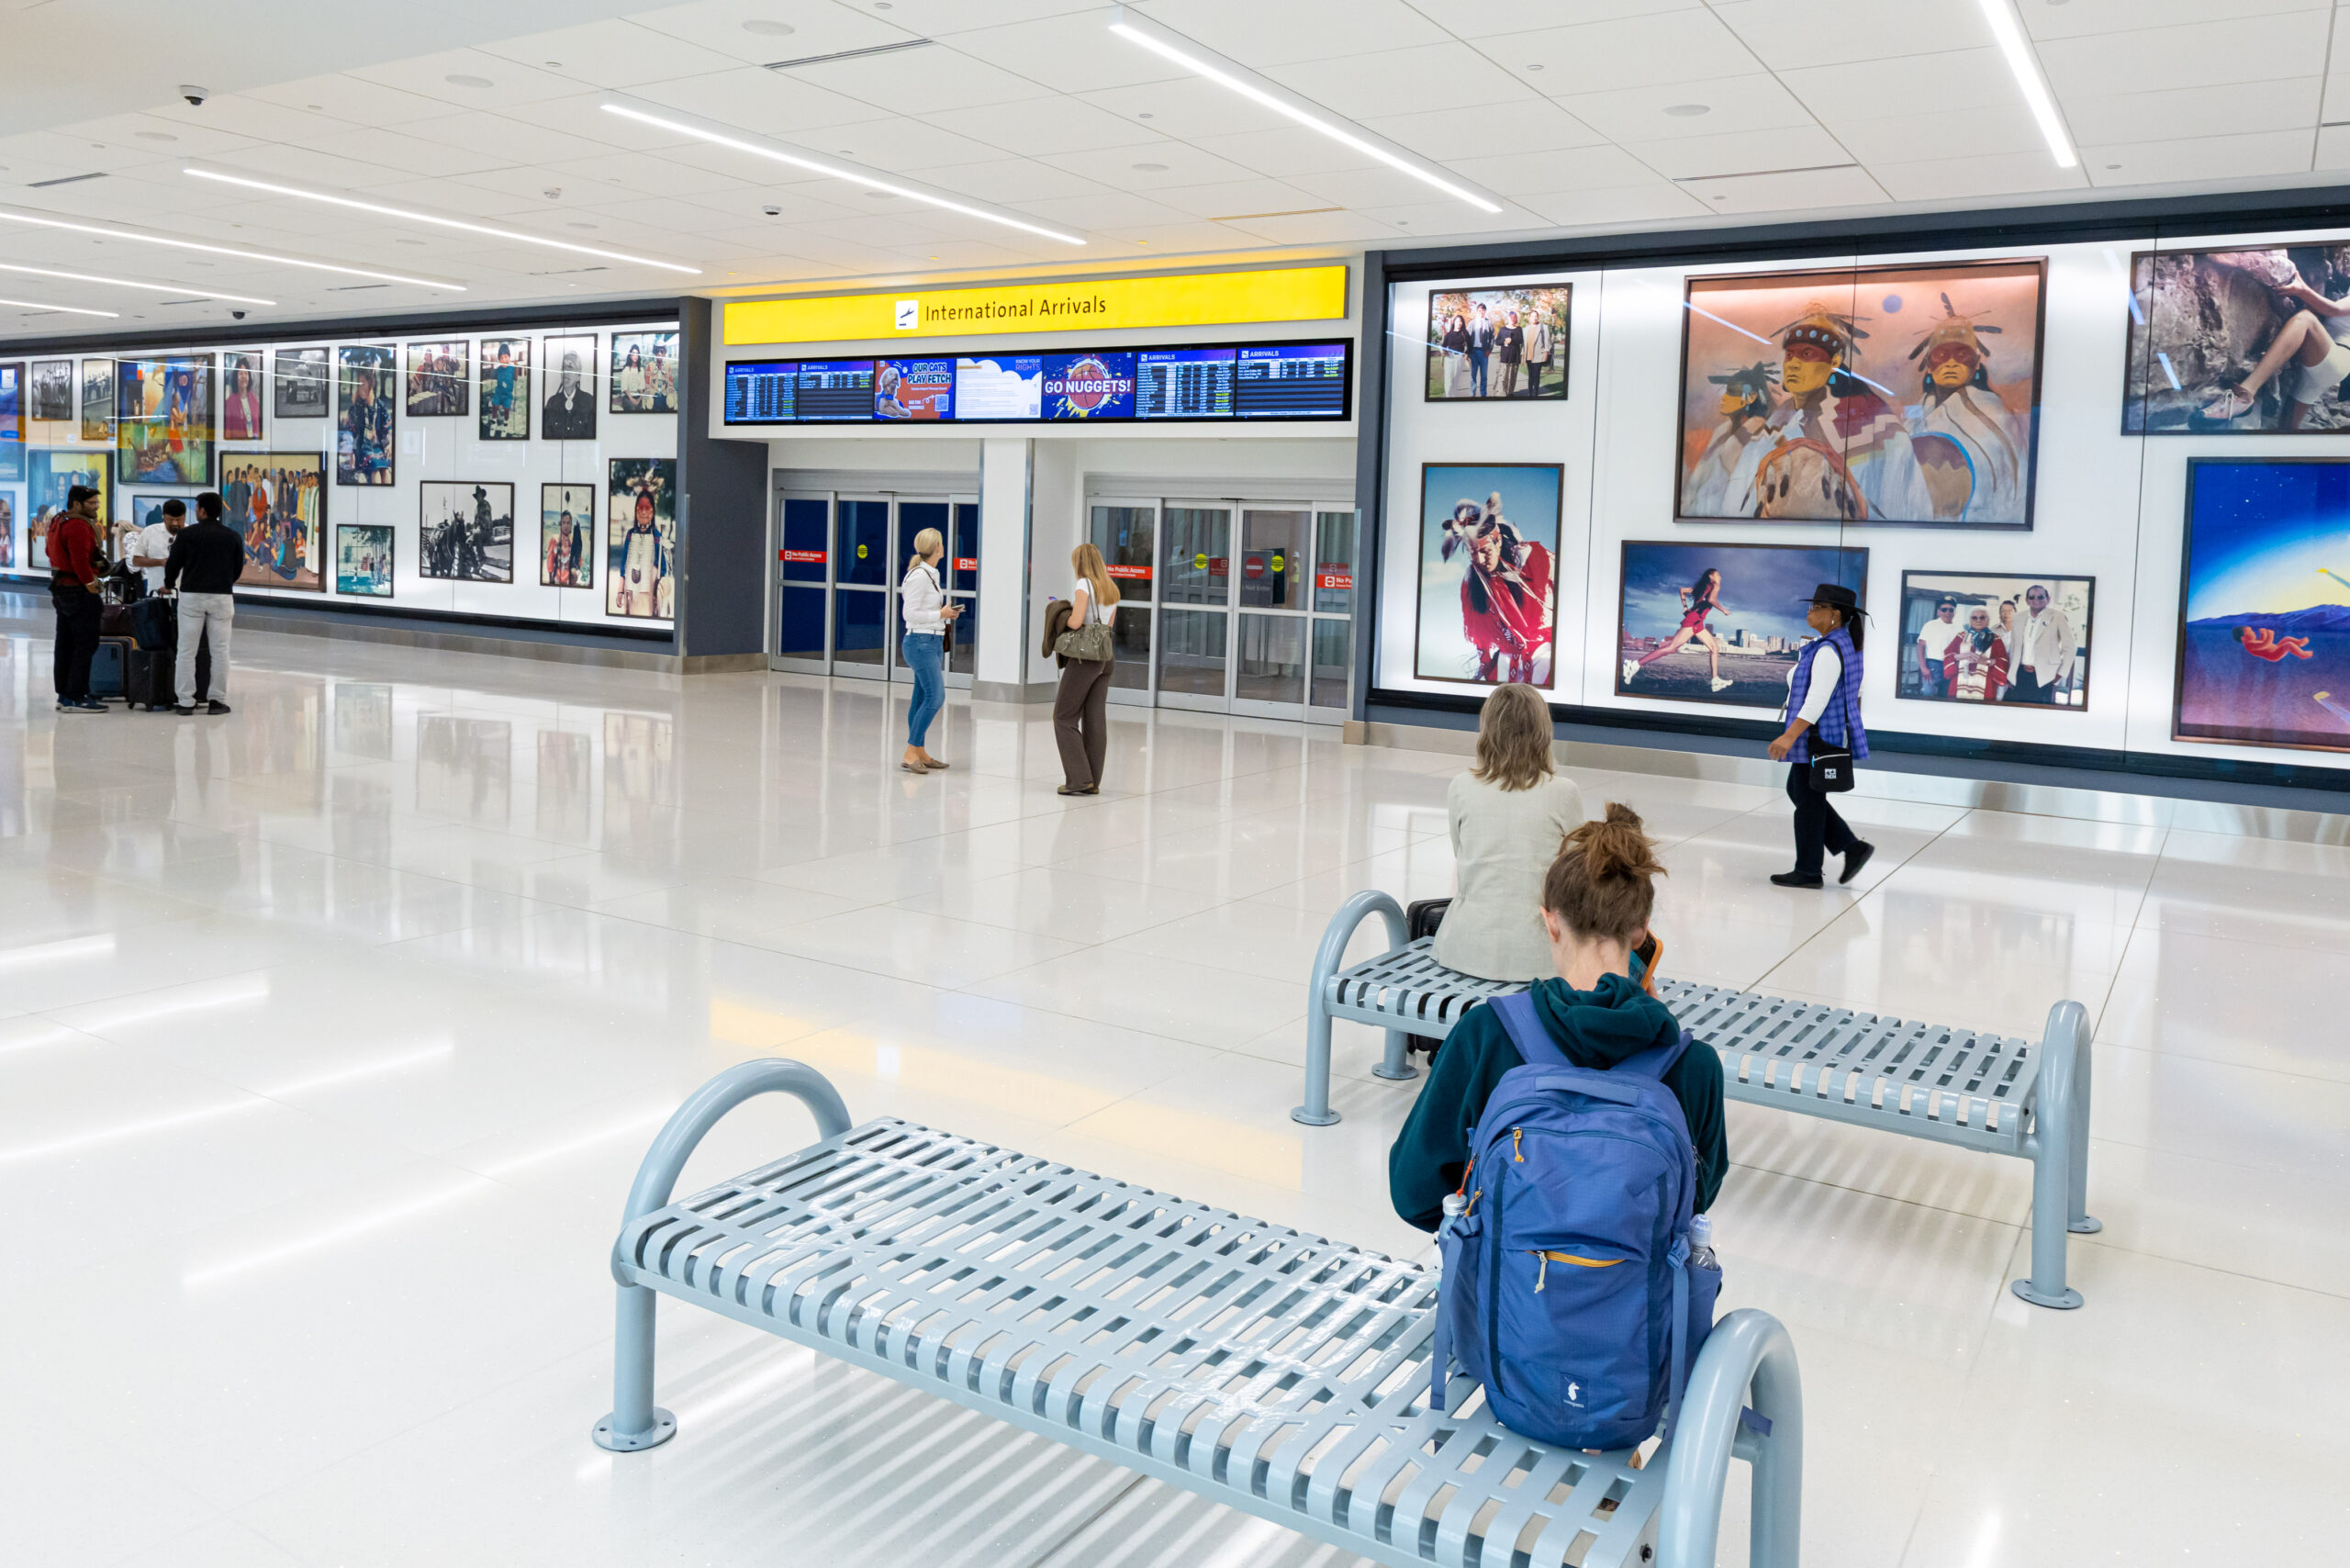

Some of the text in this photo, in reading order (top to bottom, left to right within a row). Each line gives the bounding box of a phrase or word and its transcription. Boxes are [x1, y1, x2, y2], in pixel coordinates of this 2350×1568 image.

[925, 295, 1107, 321] International Arrivals
[1249, 350, 1280, 358] ARRIVALS
[912, 363, 928, 373] OUR
[929, 362, 947, 372] CATS
[907, 373, 952, 385] PLAY FETCH
[1045, 379, 1132, 394] GO NUGGETS!
